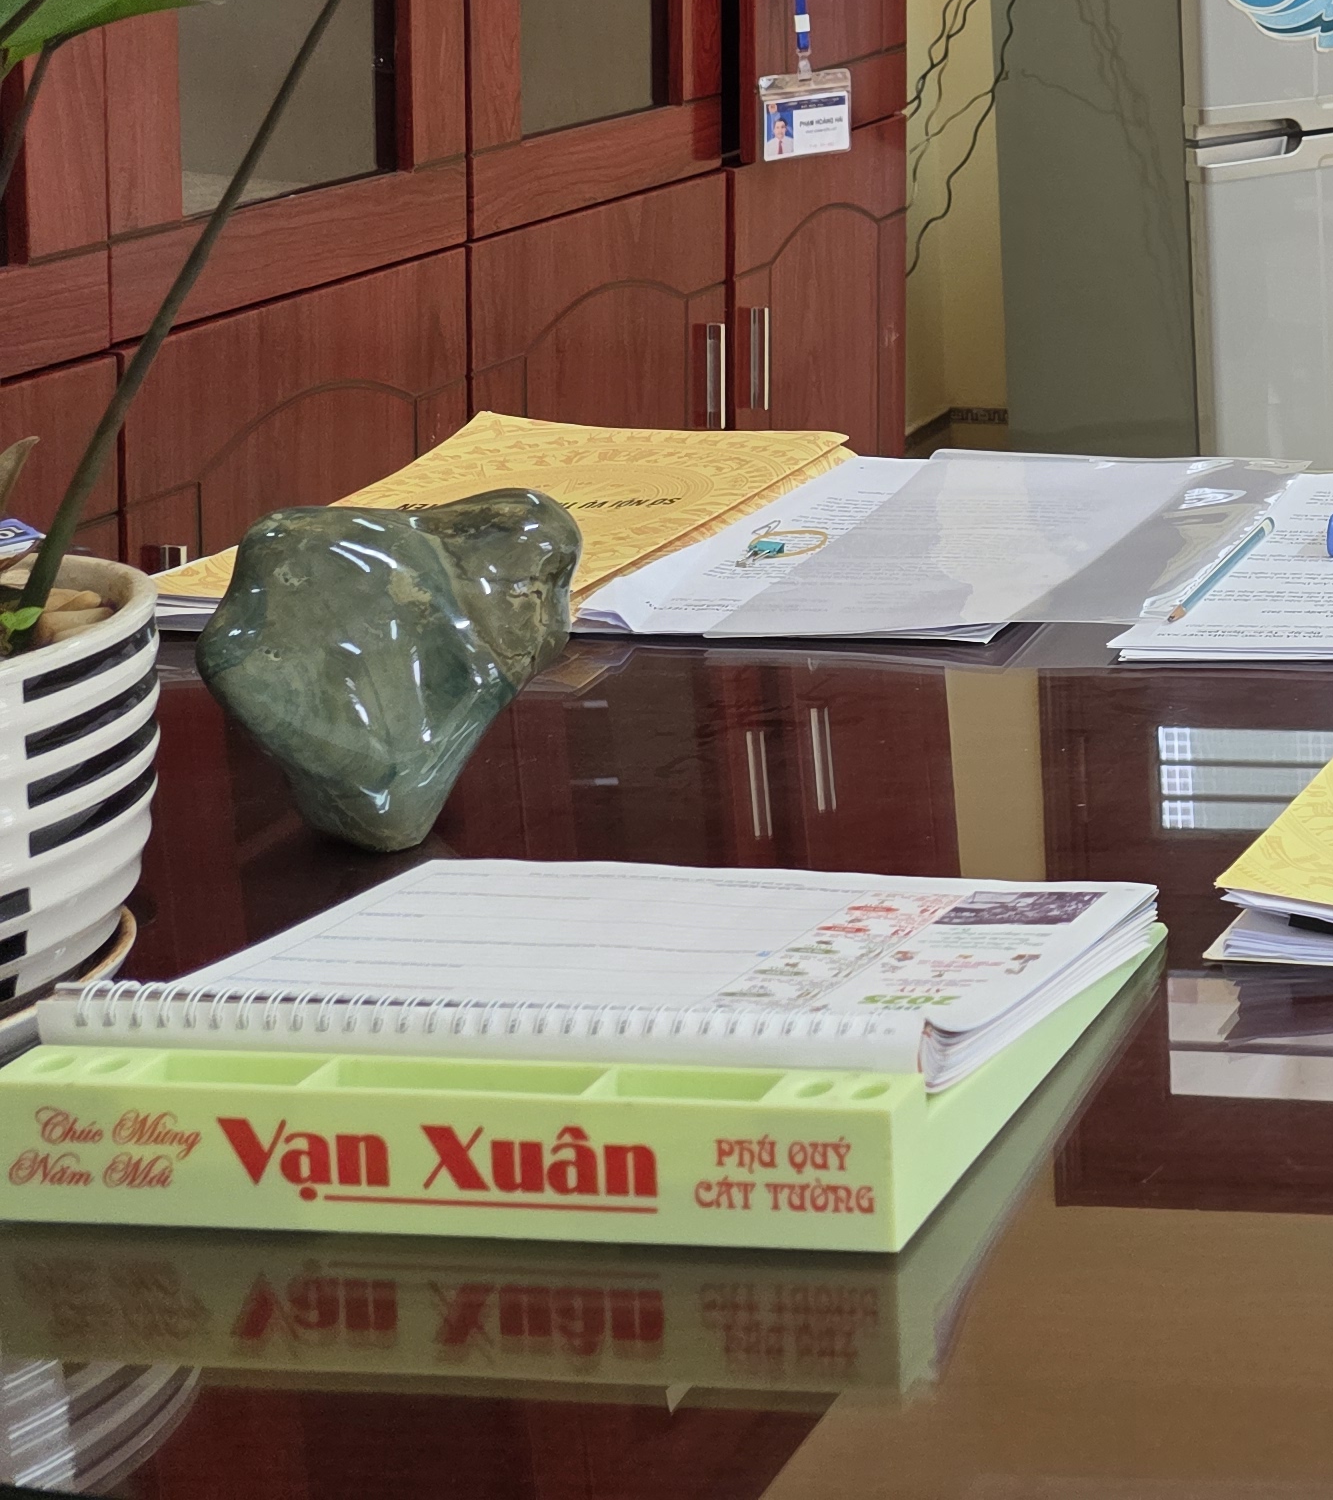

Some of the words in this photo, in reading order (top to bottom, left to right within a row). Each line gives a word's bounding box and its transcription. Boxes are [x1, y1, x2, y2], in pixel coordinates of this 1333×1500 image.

[34, 1105, 104, 1146] Chúc
[111, 1108, 202, 1161] Mừng
[8, 1148, 95, 1186] Năm
[102, 1151, 173, 1189] Mới
[216, 1116, 390, 1202] Vạn
[420, 1124, 658, 1198] Xuân
[787, 1135, 852, 1175] QUÝ
[694, 1174, 756, 1210] CÁT
[764, 1177, 876, 1215] TƯỜNG
